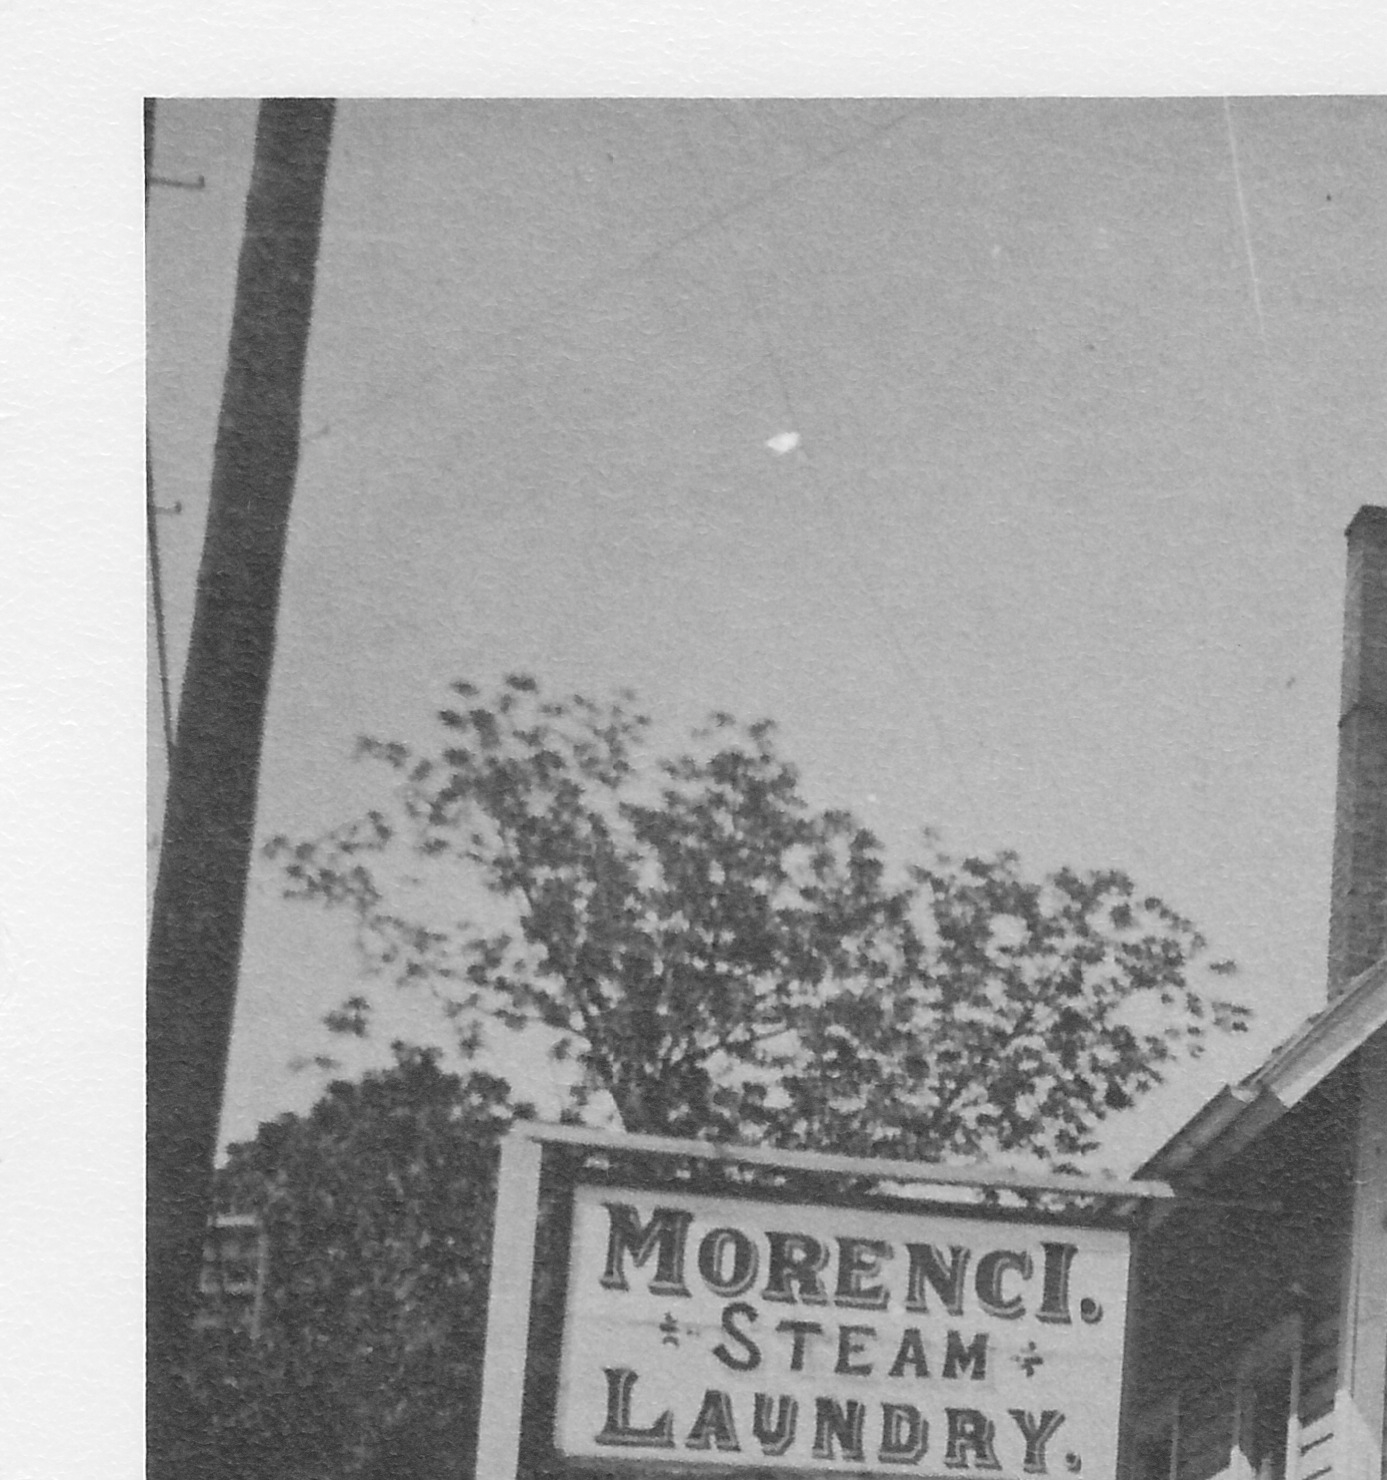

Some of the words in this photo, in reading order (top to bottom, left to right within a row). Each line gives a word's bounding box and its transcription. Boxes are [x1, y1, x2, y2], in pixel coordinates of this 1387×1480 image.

[601, 1201, 1102, 1325] MORENCI.
[713, 1302, 988, 1380] STEAM
[597, 1367, 1081, 1474] LAUNDRY.
